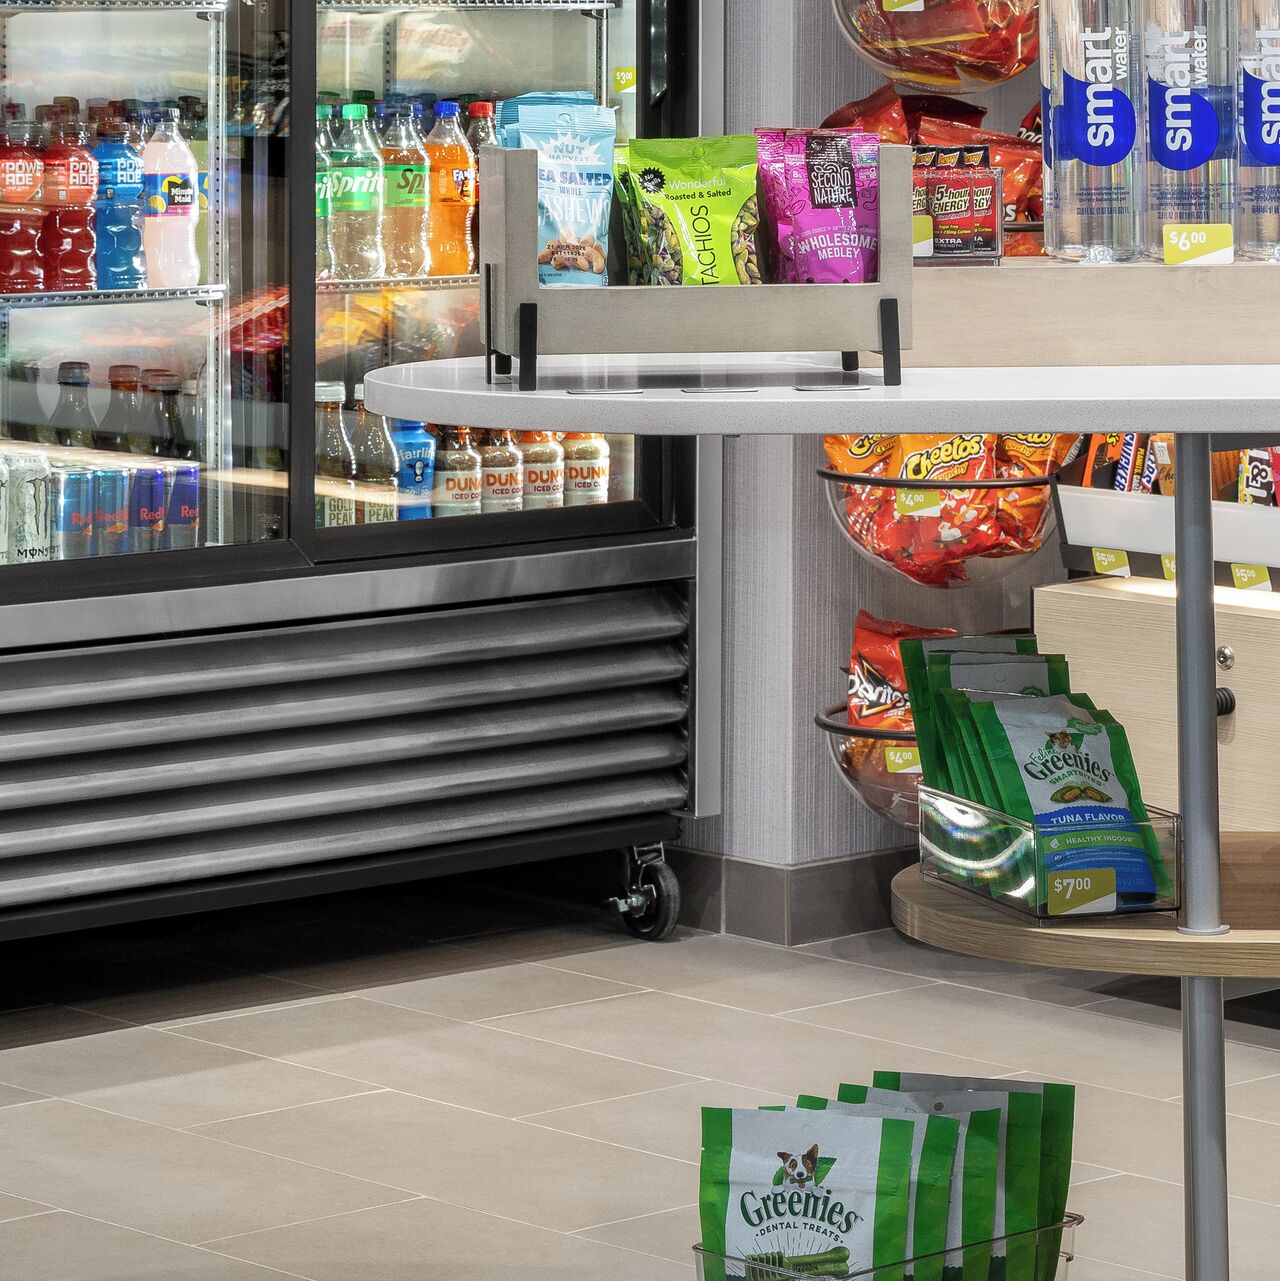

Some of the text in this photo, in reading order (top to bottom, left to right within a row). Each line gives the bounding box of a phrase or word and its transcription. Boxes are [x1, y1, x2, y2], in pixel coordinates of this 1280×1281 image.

[1079, 26, 1128, 147] smart water
[1159, 26, 1208, 151] smart water
[554, 144, 585, 155] NUT
[669, 177, 727, 191] Wonderful
[812, 170, 852, 189] SECOND
[559, 187, 582, 196] WHOLE
[698, 191, 705, 199] &
[707, 188, 732, 198] Salted
[812, 186, 852, 206] NATURE
[935, 184, 969, 201] 5-hour
[933, 198, 969, 215] ENERGY
[690, 205, 720, 285] TACHIOS
[798, 234, 878, 254] WHOLESOME
[817, 246, 860, 260] MEDLEY
[906, 434, 984, 479] Cheetos
[1024, 751, 1111, 783] Greenies
[1051, 814, 1082, 824] TUNA
[1066, 835, 1134, 844] HEALTHY INDOOR
[740, 1189, 858, 1235] Greenies
[759, 1221, 841, 1243] DENTAL TREATS
